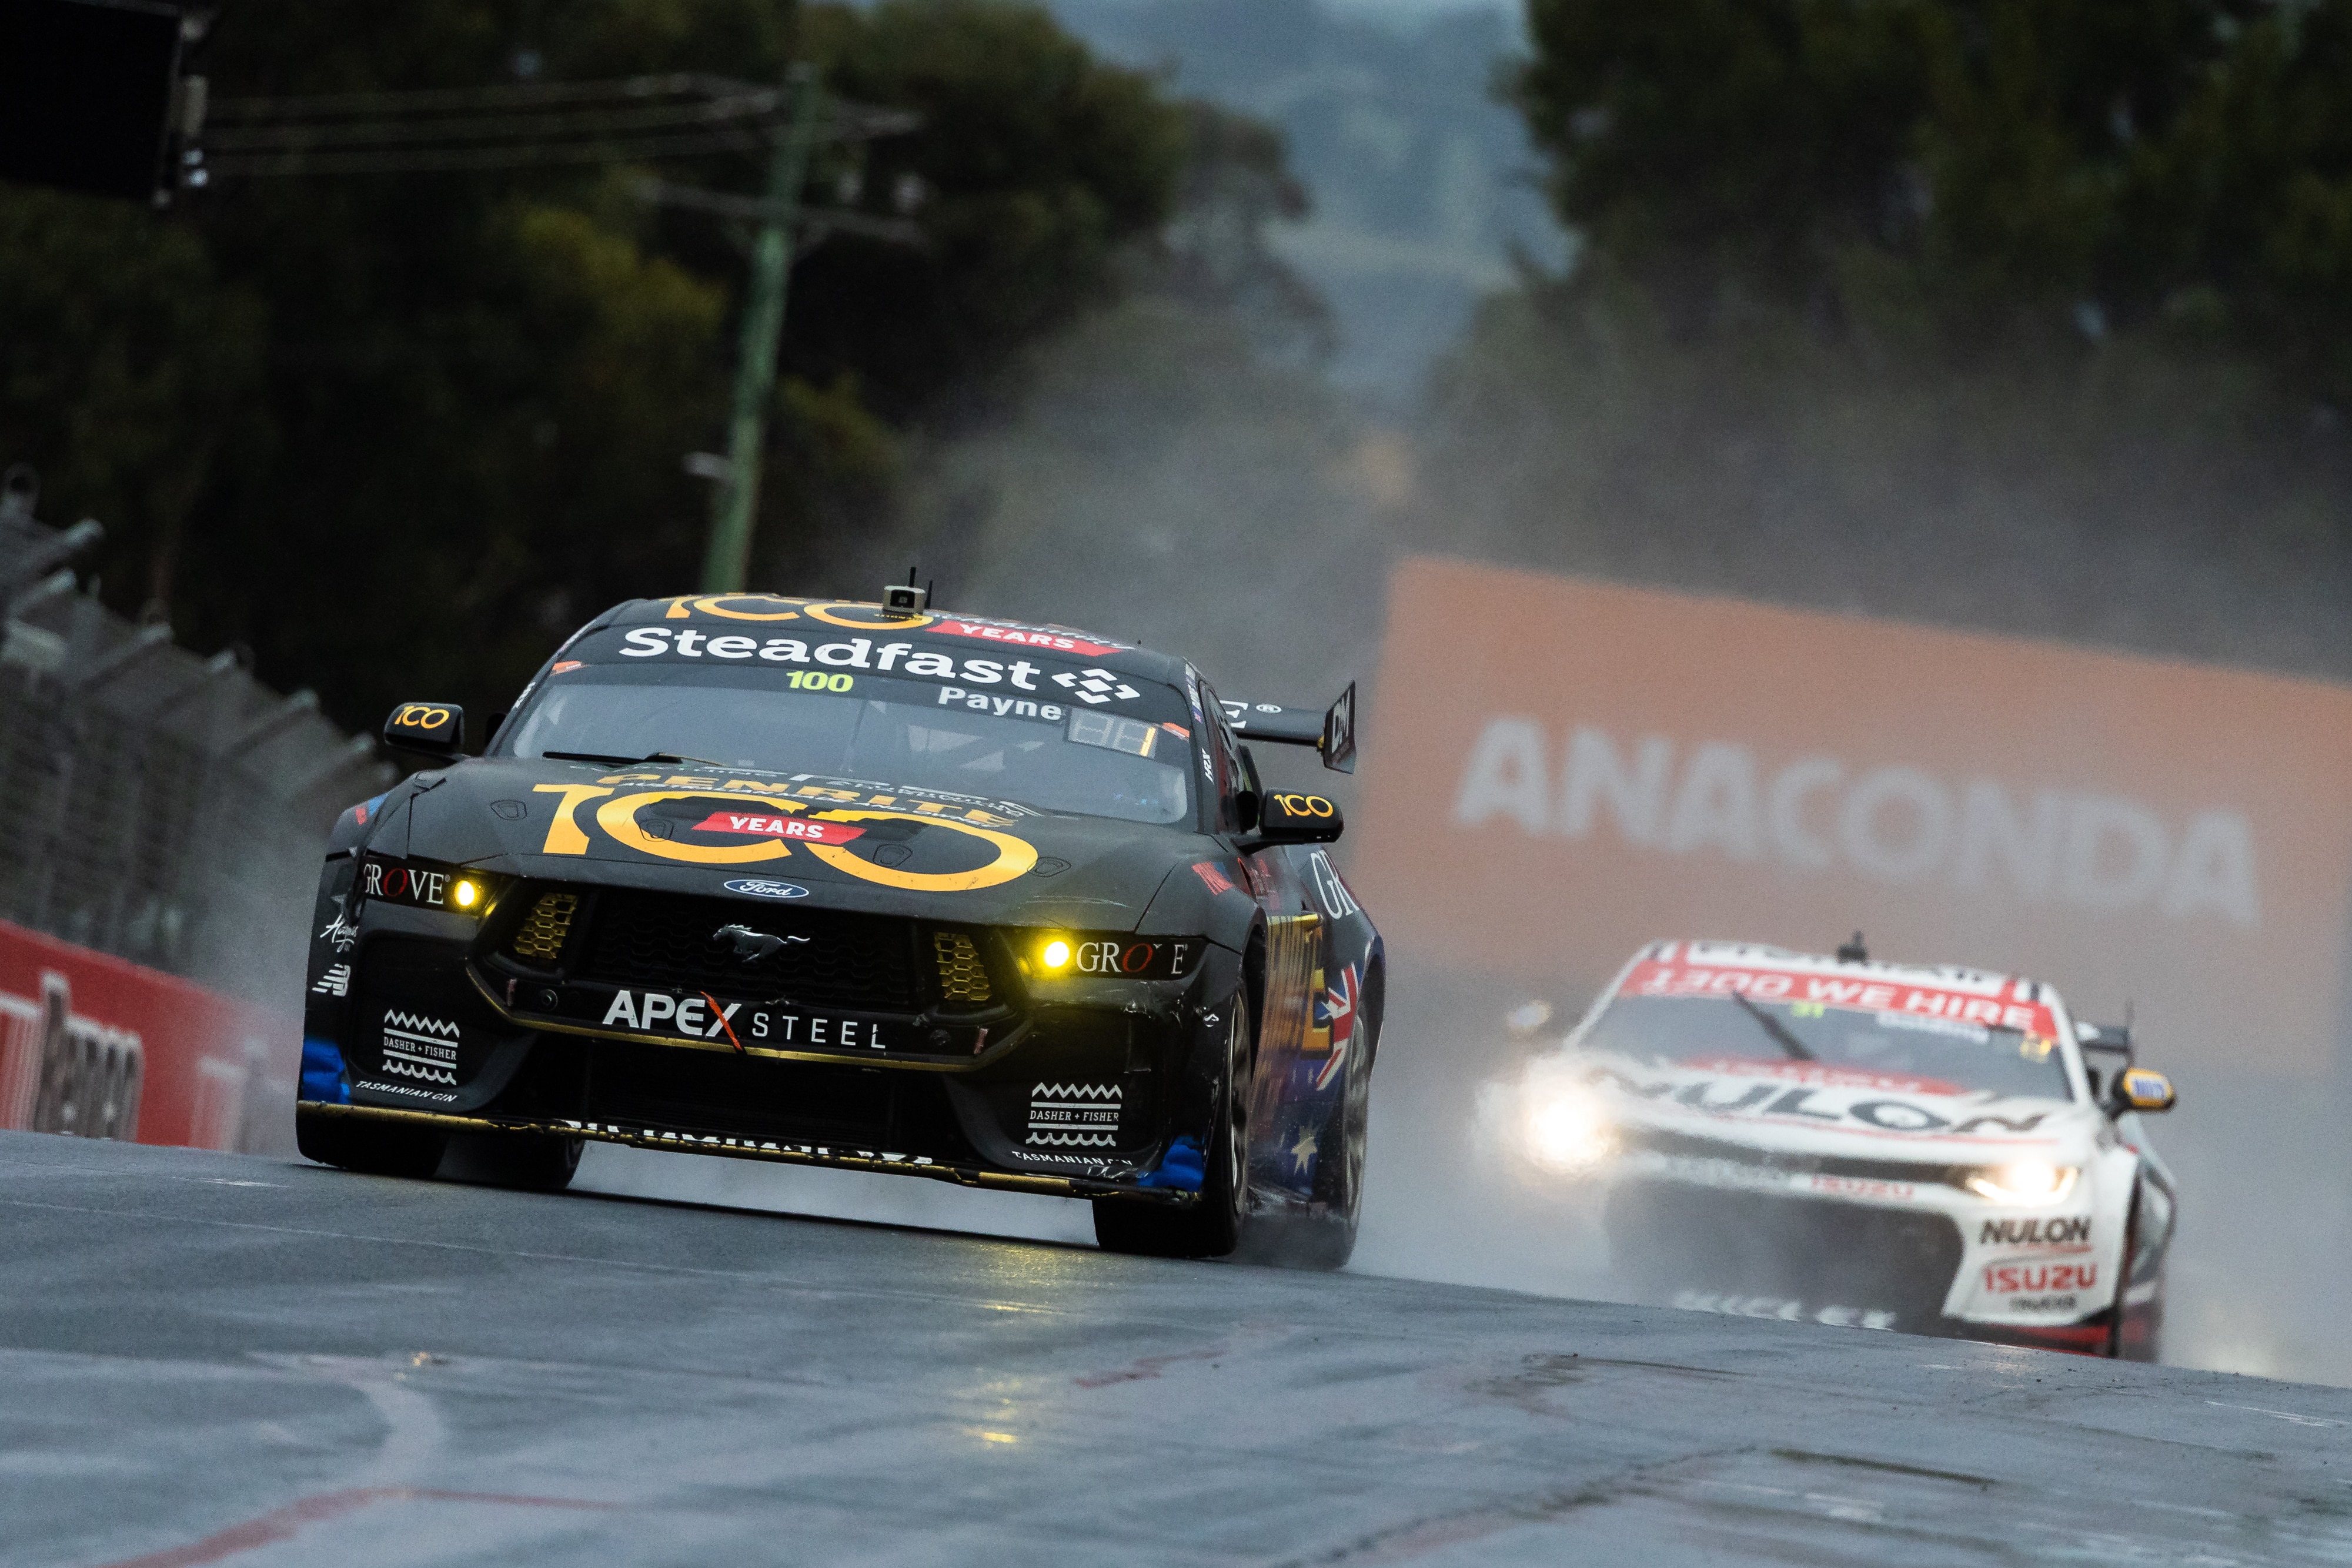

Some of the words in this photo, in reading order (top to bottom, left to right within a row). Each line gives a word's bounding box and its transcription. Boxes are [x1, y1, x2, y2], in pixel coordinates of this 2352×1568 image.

[960, 624, 1075, 649] YEARS
[618, 627, 1041, 691] Steadfast
[786, 670, 854, 693] 100
[938, 686, 1062, 721] Payne
[597, 773, 1018, 827] PENRITE
[729, 815, 825, 839] YEARS
[1455, 715, 2261, 927] ANACONDA
[363, 863, 444, 904] GROVE
[1076, 942, 1184, 975] GROE
[1807, 977, 1897, 1005] WE
[1905, 989, 2036, 1026] HIRE
[602, 989, 743, 1051] APEX
[752, 1012, 886, 1049] STEEL
[383, 1036, 415, 1052] DASHER
[425, 1045, 457, 1061] FISHER
[355, 1080, 434, 1099] TASMANIAN
[432, 1092, 458, 1102] GIN
[1030, 1109, 1071, 1121] DASHER
[1083, 1111, 1120, 1122] FISHER
[1012, 1151, 1104, 1166] TASMANIAN
[1980, 1216, 2092, 1245] NULON
[1983, 1263, 2097, 1293] ISUZU
